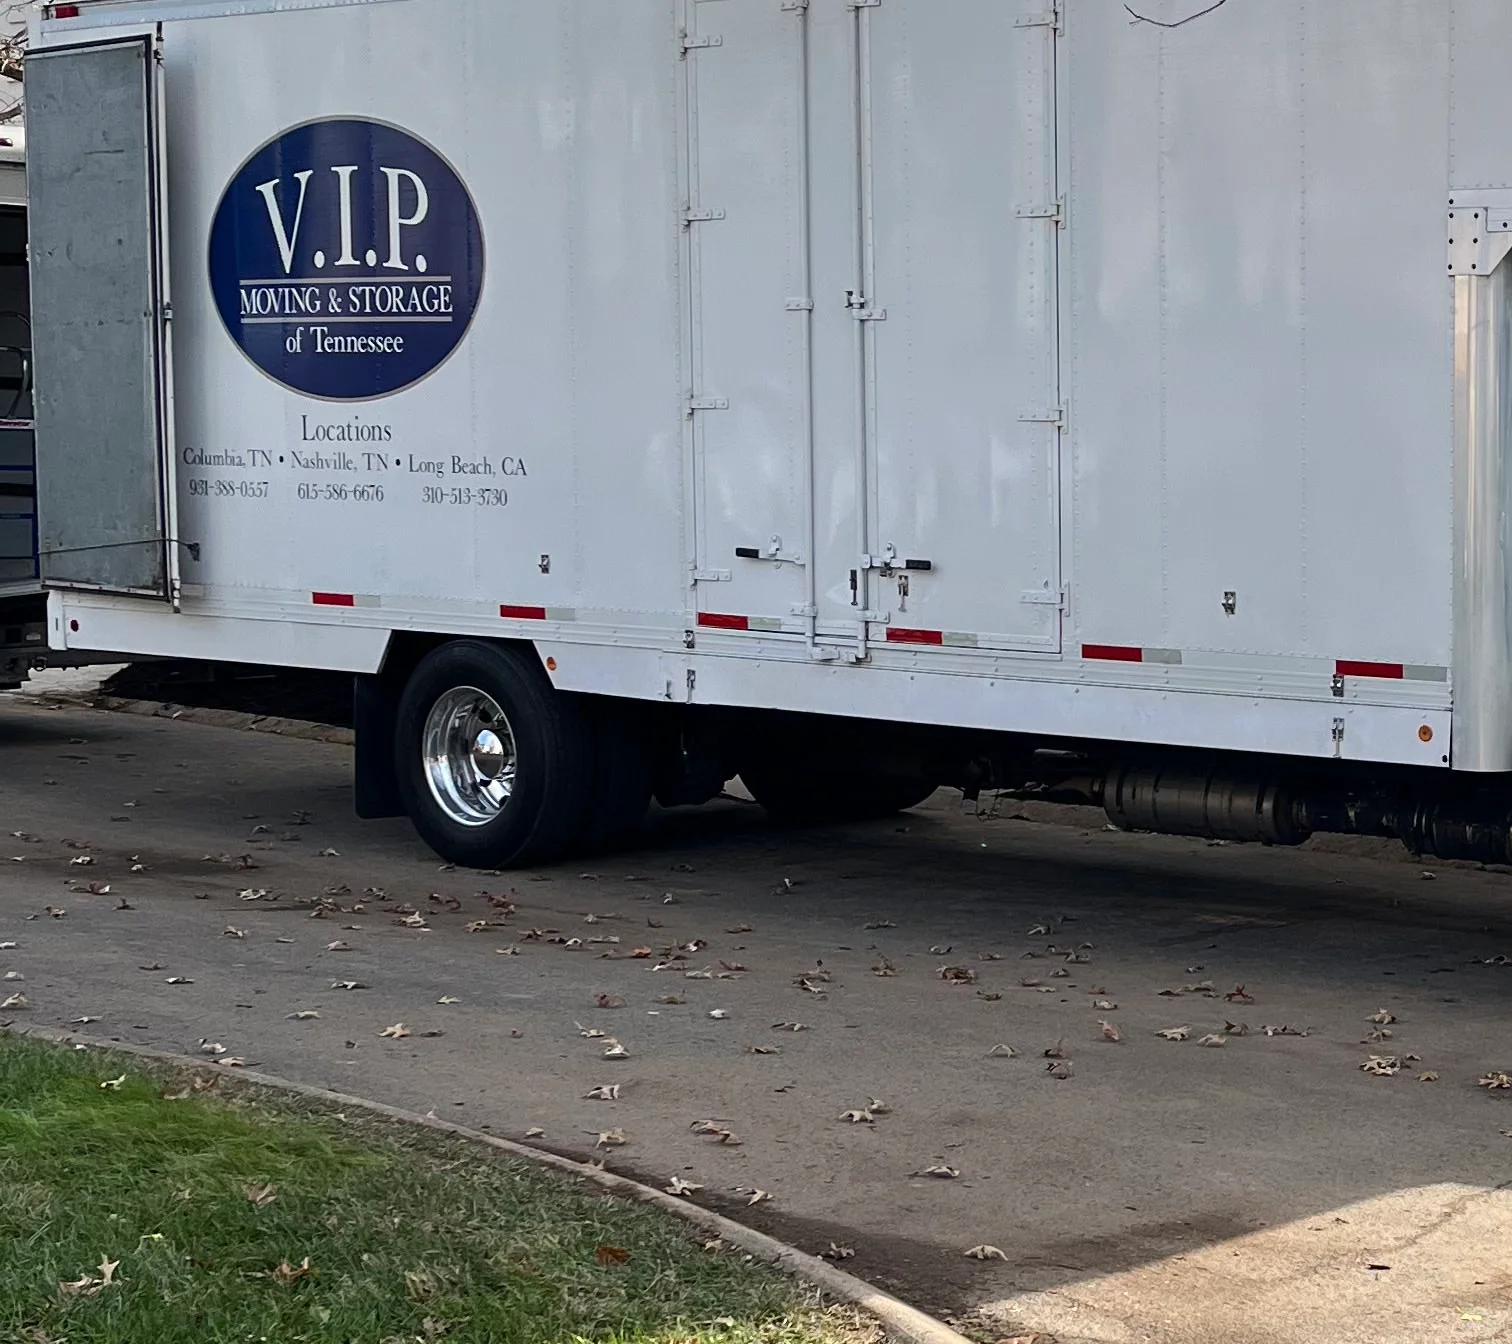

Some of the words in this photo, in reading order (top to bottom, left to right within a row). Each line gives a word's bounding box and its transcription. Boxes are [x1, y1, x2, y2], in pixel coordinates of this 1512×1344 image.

[255, 165, 429, 275] V.I.P.
[240, 287, 322, 315] MOVING
[327, 286, 343, 314] &
[348, 285, 454, 314] STORAGE
[285, 326, 304, 354] of
[309, 326, 404, 354] Tennessee
[301, 415, 392, 443] Locations
[183, 447, 246, 469] Columbia,
[247, 449, 273, 467] TN
[291, 450, 357, 473] Nashville,
[362, 452, 389, 472] TN
[408, 454, 445, 479] Long
[451, 455, 496, 478] Beach,
[501, 456, 527, 476] CA
[298, 482, 384, 502] 615-586-6676
[422, 485, 508, 507] 310-513-3730
